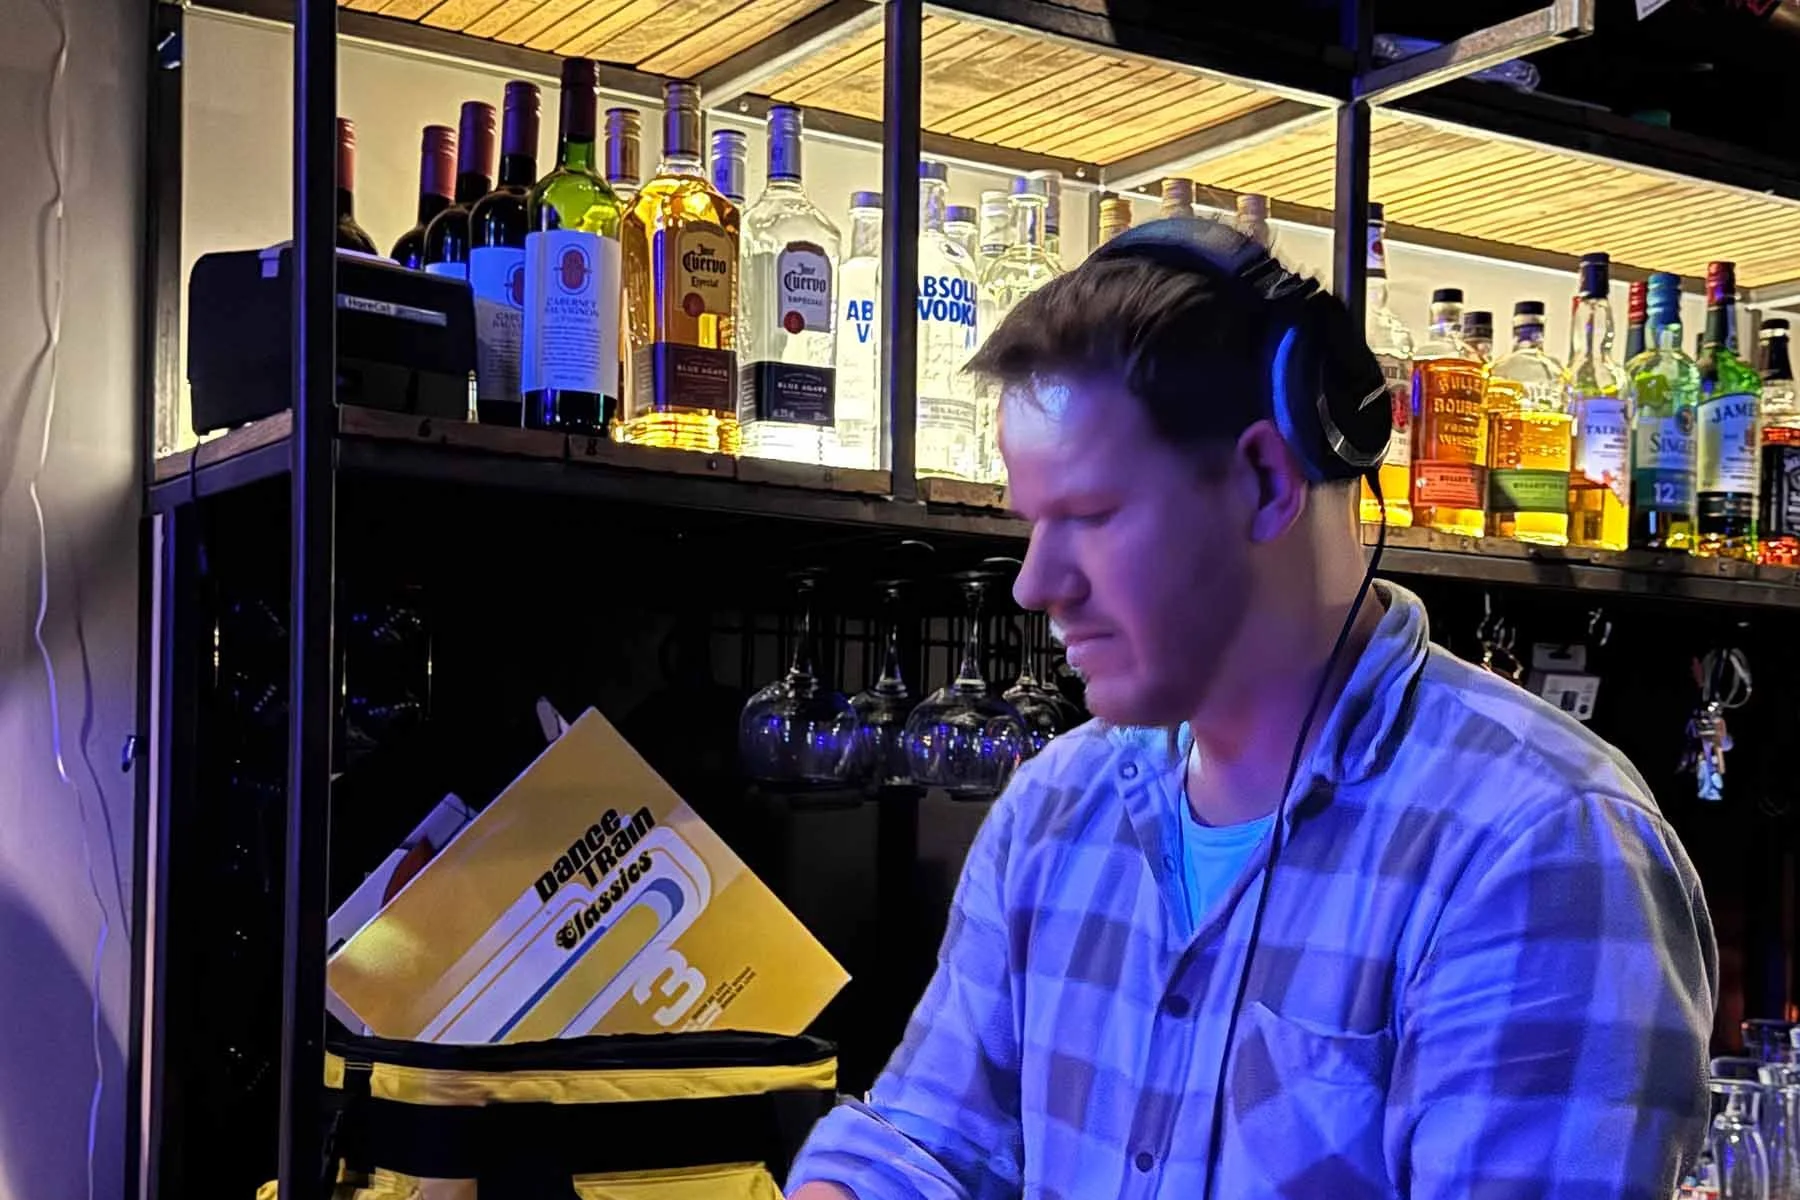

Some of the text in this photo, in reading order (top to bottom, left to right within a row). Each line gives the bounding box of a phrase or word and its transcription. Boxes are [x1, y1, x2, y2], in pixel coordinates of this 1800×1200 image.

[682, 250, 727, 274] Cuervo
[783, 269, 826, 293] Cuervo
[918, 275, 978, 305] BSOLU
[1653, 482, 1675, 504] 12
[555, 850, 653, 949] Classics
[632, 948, 707, 1028] 3
